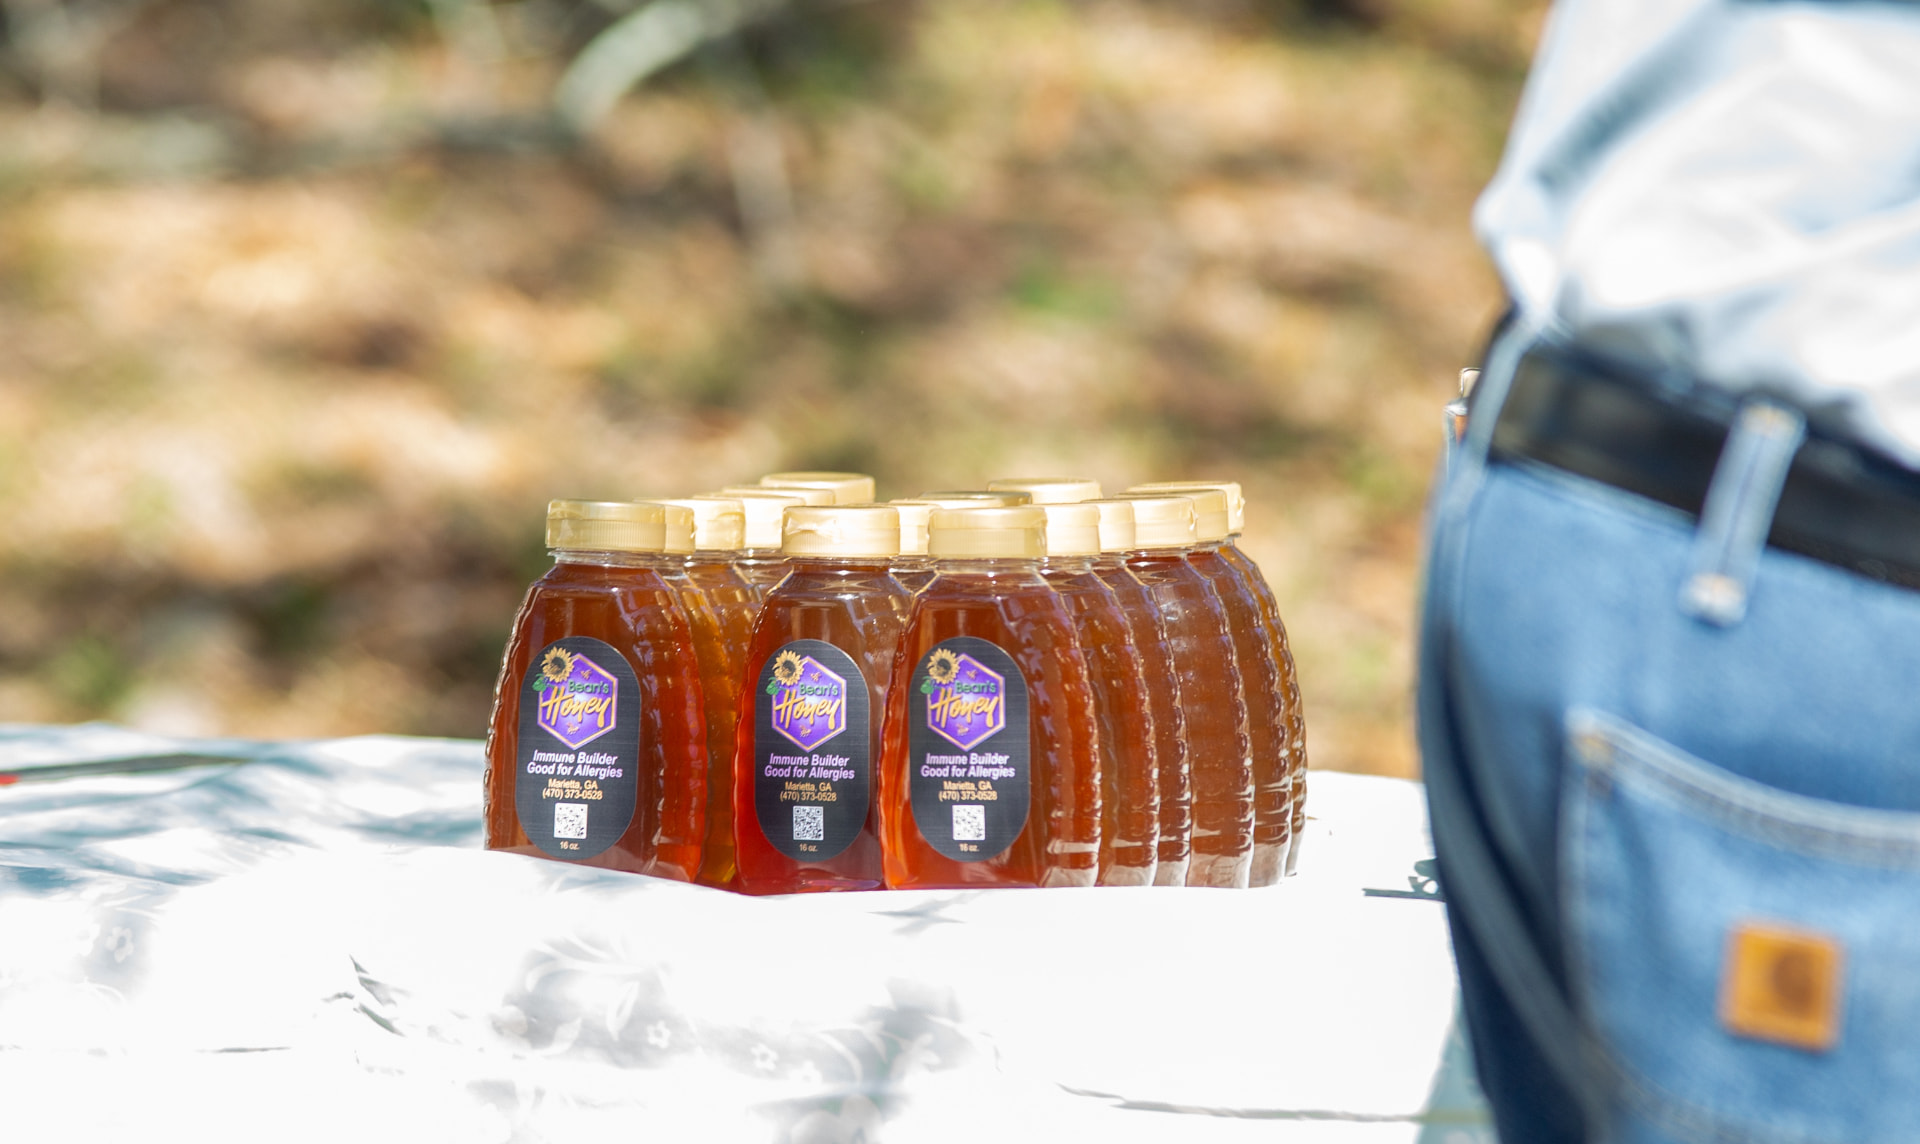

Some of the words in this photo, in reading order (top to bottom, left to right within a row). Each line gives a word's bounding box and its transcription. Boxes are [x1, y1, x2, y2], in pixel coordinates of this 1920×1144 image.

[568, 680, 609, 693] Bean's
[800, 683, 838, 696] Bean's
[955, 680, 996, 693] Bean's
[540, 686, 611, 728] Honey
[774, 689, 840, 730] Honey
[929, 687, 999, 728] Honey
[533, 749, 575, 763] Immune
[577, 752, 618, 765] Builder
[769, 753, 809, 765] Immune
[811, 754, 849, 767] Builder
[926, 753, 968, 765] Immune
[969, 753, 1009, 765] Builder
[527, 762, 556, 774] Good
[557, 763, 573, 775] for
[574, 764, 623, 779] Allergies
[764, 765, 791, 777] Good
[793, 766, 807, 778] for
[809, 767, 855, 781] Allergies
[921, 765, 949, 777] Good
[951, 765, 967, 777] for
[967, 766, 1015, 780] Allergies
[548, 778, 582, 790] Marietta,
[584, 780, 598, 789] GA
[785, 781, 817, 792] Marietta,
[819, 782, 832, 791] GA
[943, 781, 977, 791] Marietta,
[978, 781, 992, 790] GA
[542, 788, 564, 800] (470)
[564, 789, 603, 800] 373-0528
[780, 791, 799, 802] (470)
[801, 792, 837, 801] 373-0528
[938, 791, 959, 802] (470)
[560, 841, 568, 849] 16
